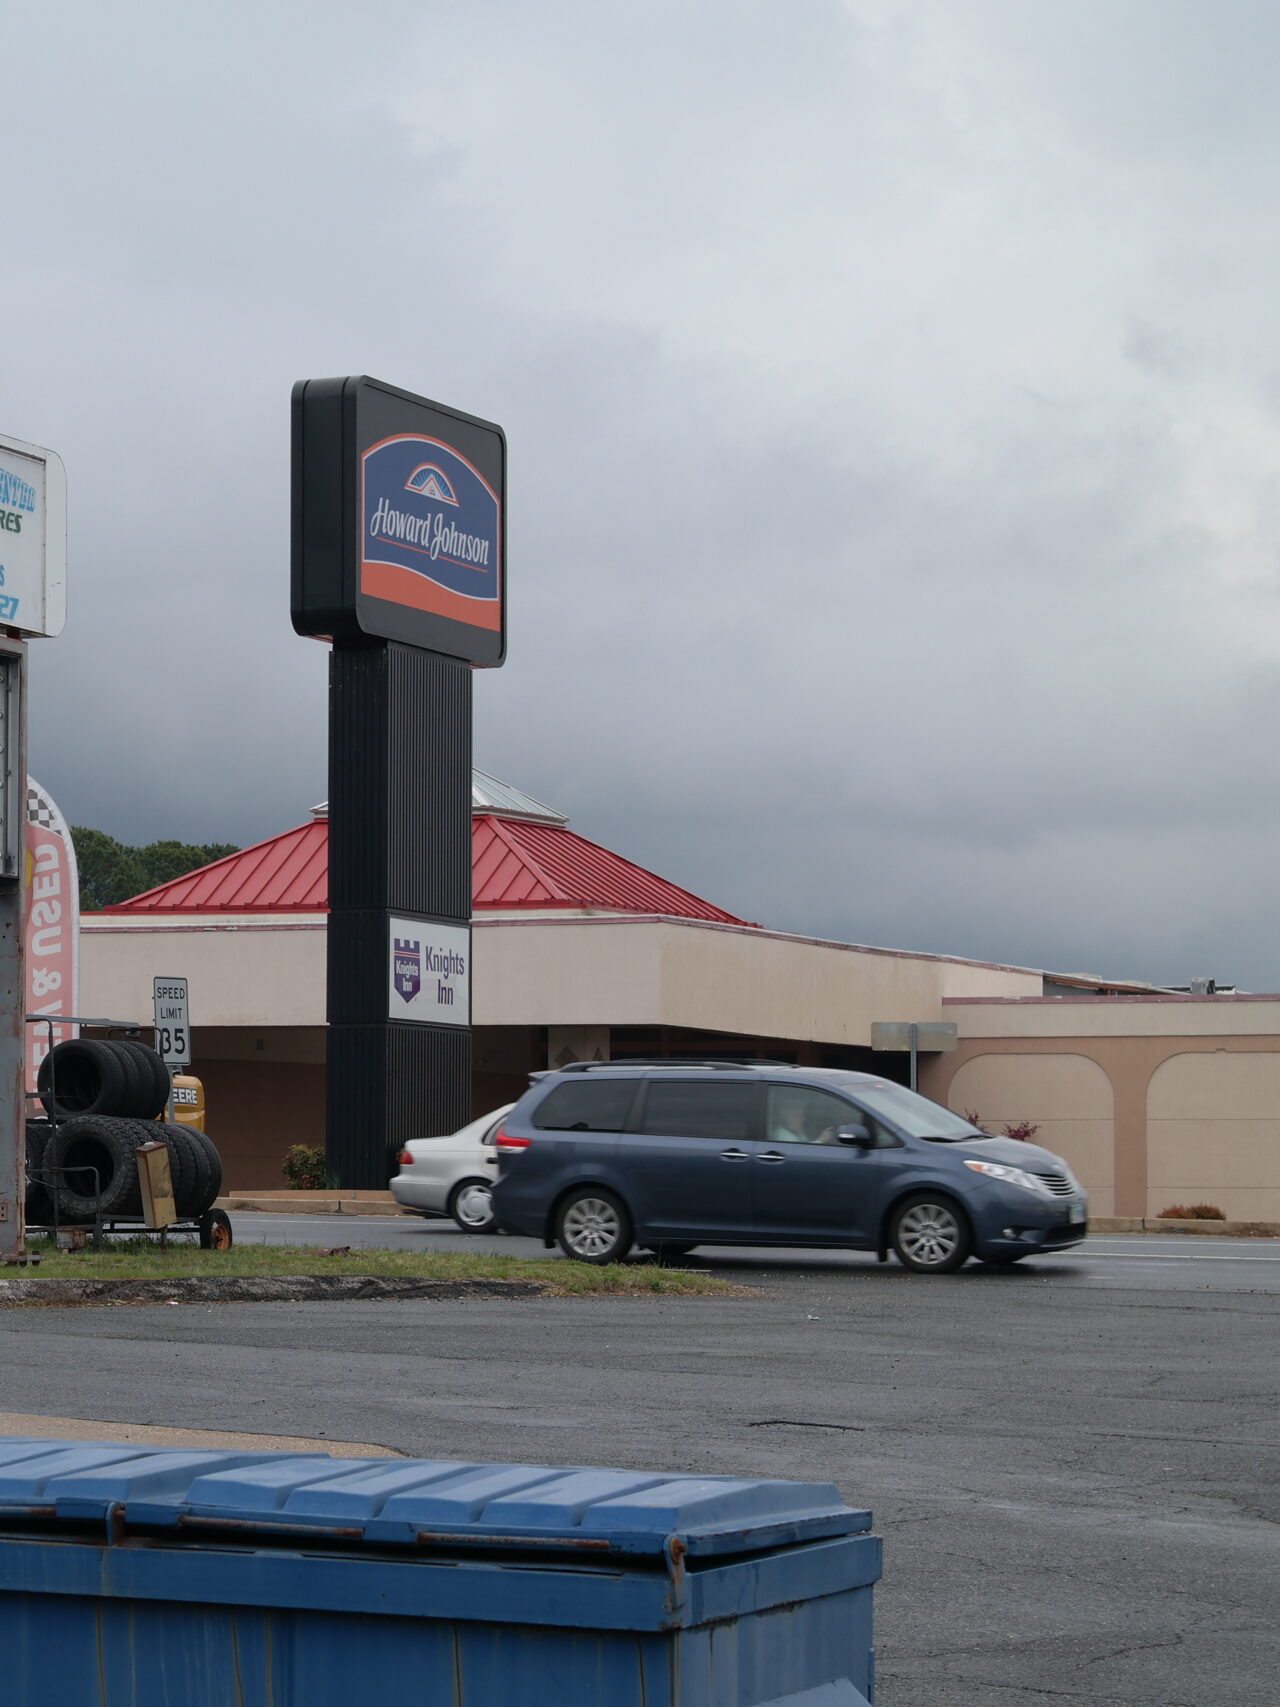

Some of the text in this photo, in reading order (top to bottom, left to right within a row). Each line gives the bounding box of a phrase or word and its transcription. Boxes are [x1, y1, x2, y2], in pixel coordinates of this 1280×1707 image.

[370, 496, 489, 566] Howard Johnson
[396, 959, 419, 979] Knights
[425, 945, 465, 980] Knights
[156, 986, 185, 1000] SPEED
[402, 977, 413, 992] Inn
[437, 979, 454, 1005] Inn
[160, 1007, 182, 1020] LIMIT
[161, 1027, 186, 1055] 35
[173, 1088, 198, 1104] EERE
